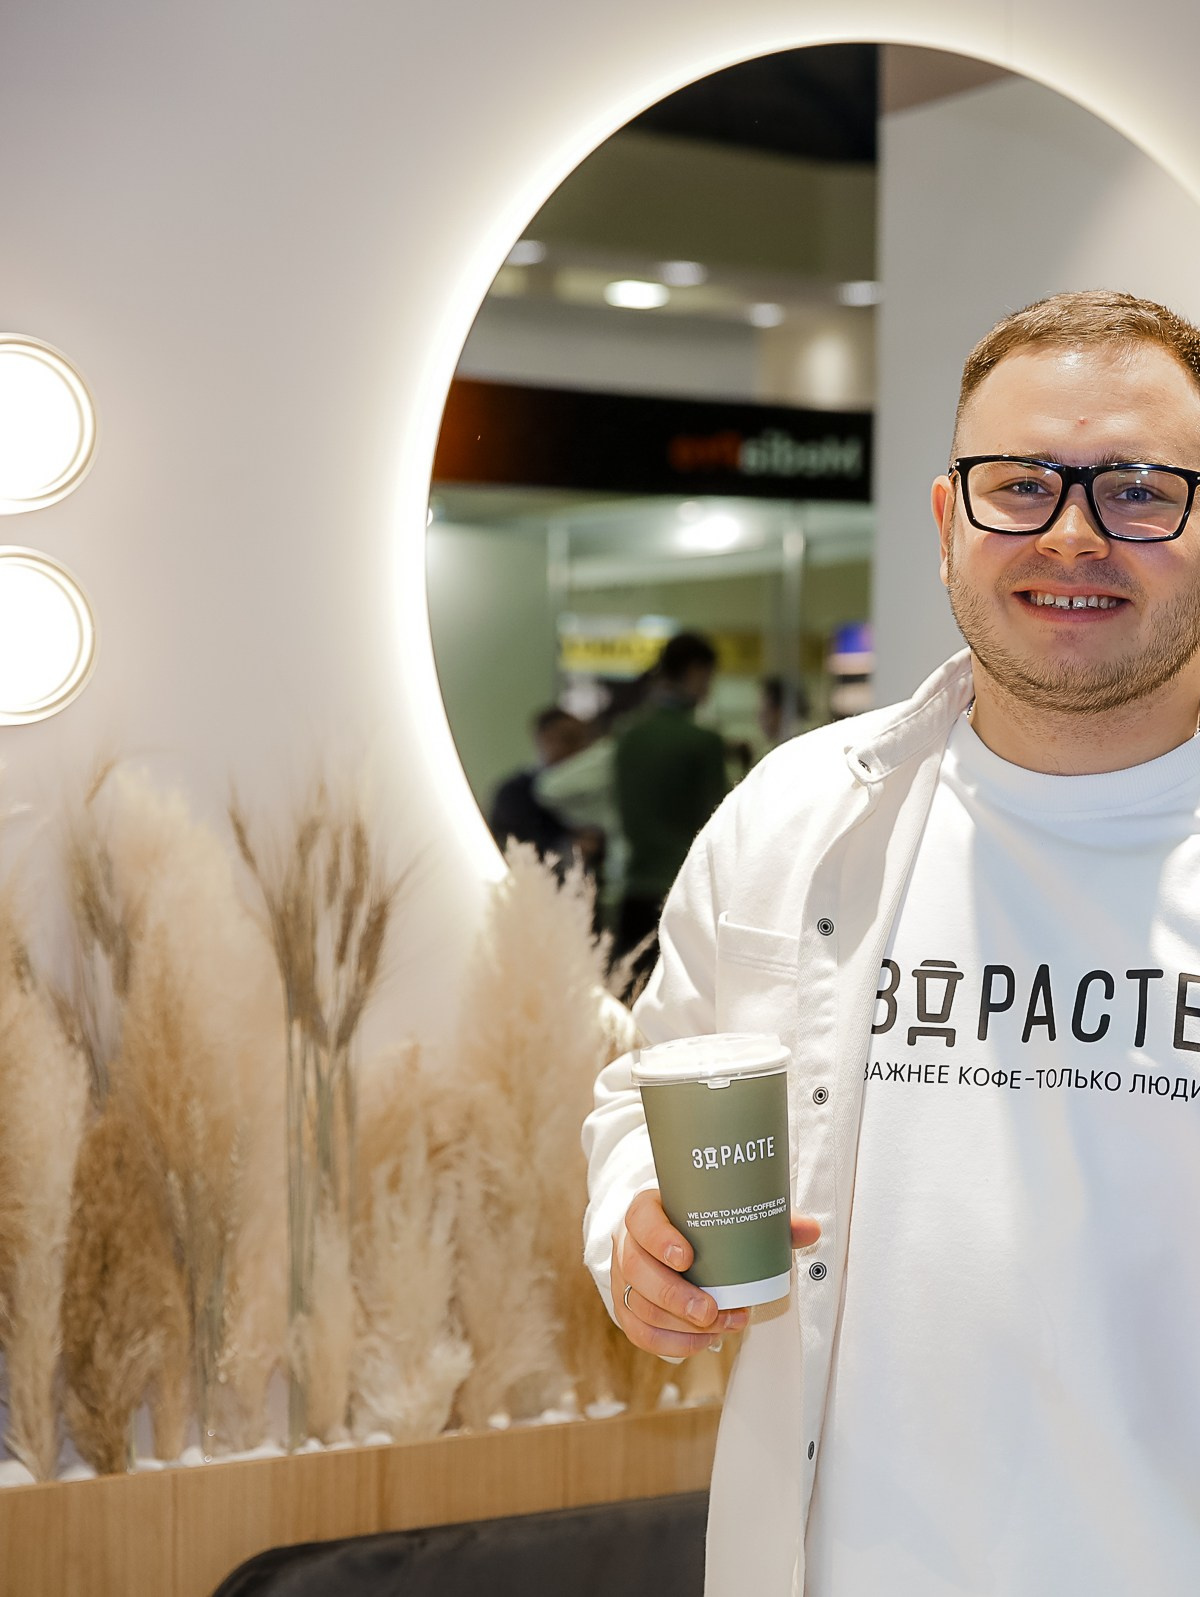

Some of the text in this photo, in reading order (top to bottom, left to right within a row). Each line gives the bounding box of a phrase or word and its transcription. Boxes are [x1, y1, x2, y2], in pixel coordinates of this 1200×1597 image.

[687, 1212, 699, 1220] WE
[700, 1211, 718, 1219] LOVE
[719, 1209, 731, 1218] TO
[731, 1206, 752, 1216] MAKE
[752, 1200, 776, 1212] COFFEE
[686, 1220, 700, 1228] THE
[700, 1219, 716, 1228] CITY
[716, 1217, 735, 1226] THAT
[736, 1213, 758, 1224] LOVES
[759, 1211, 768, 1219] TO
